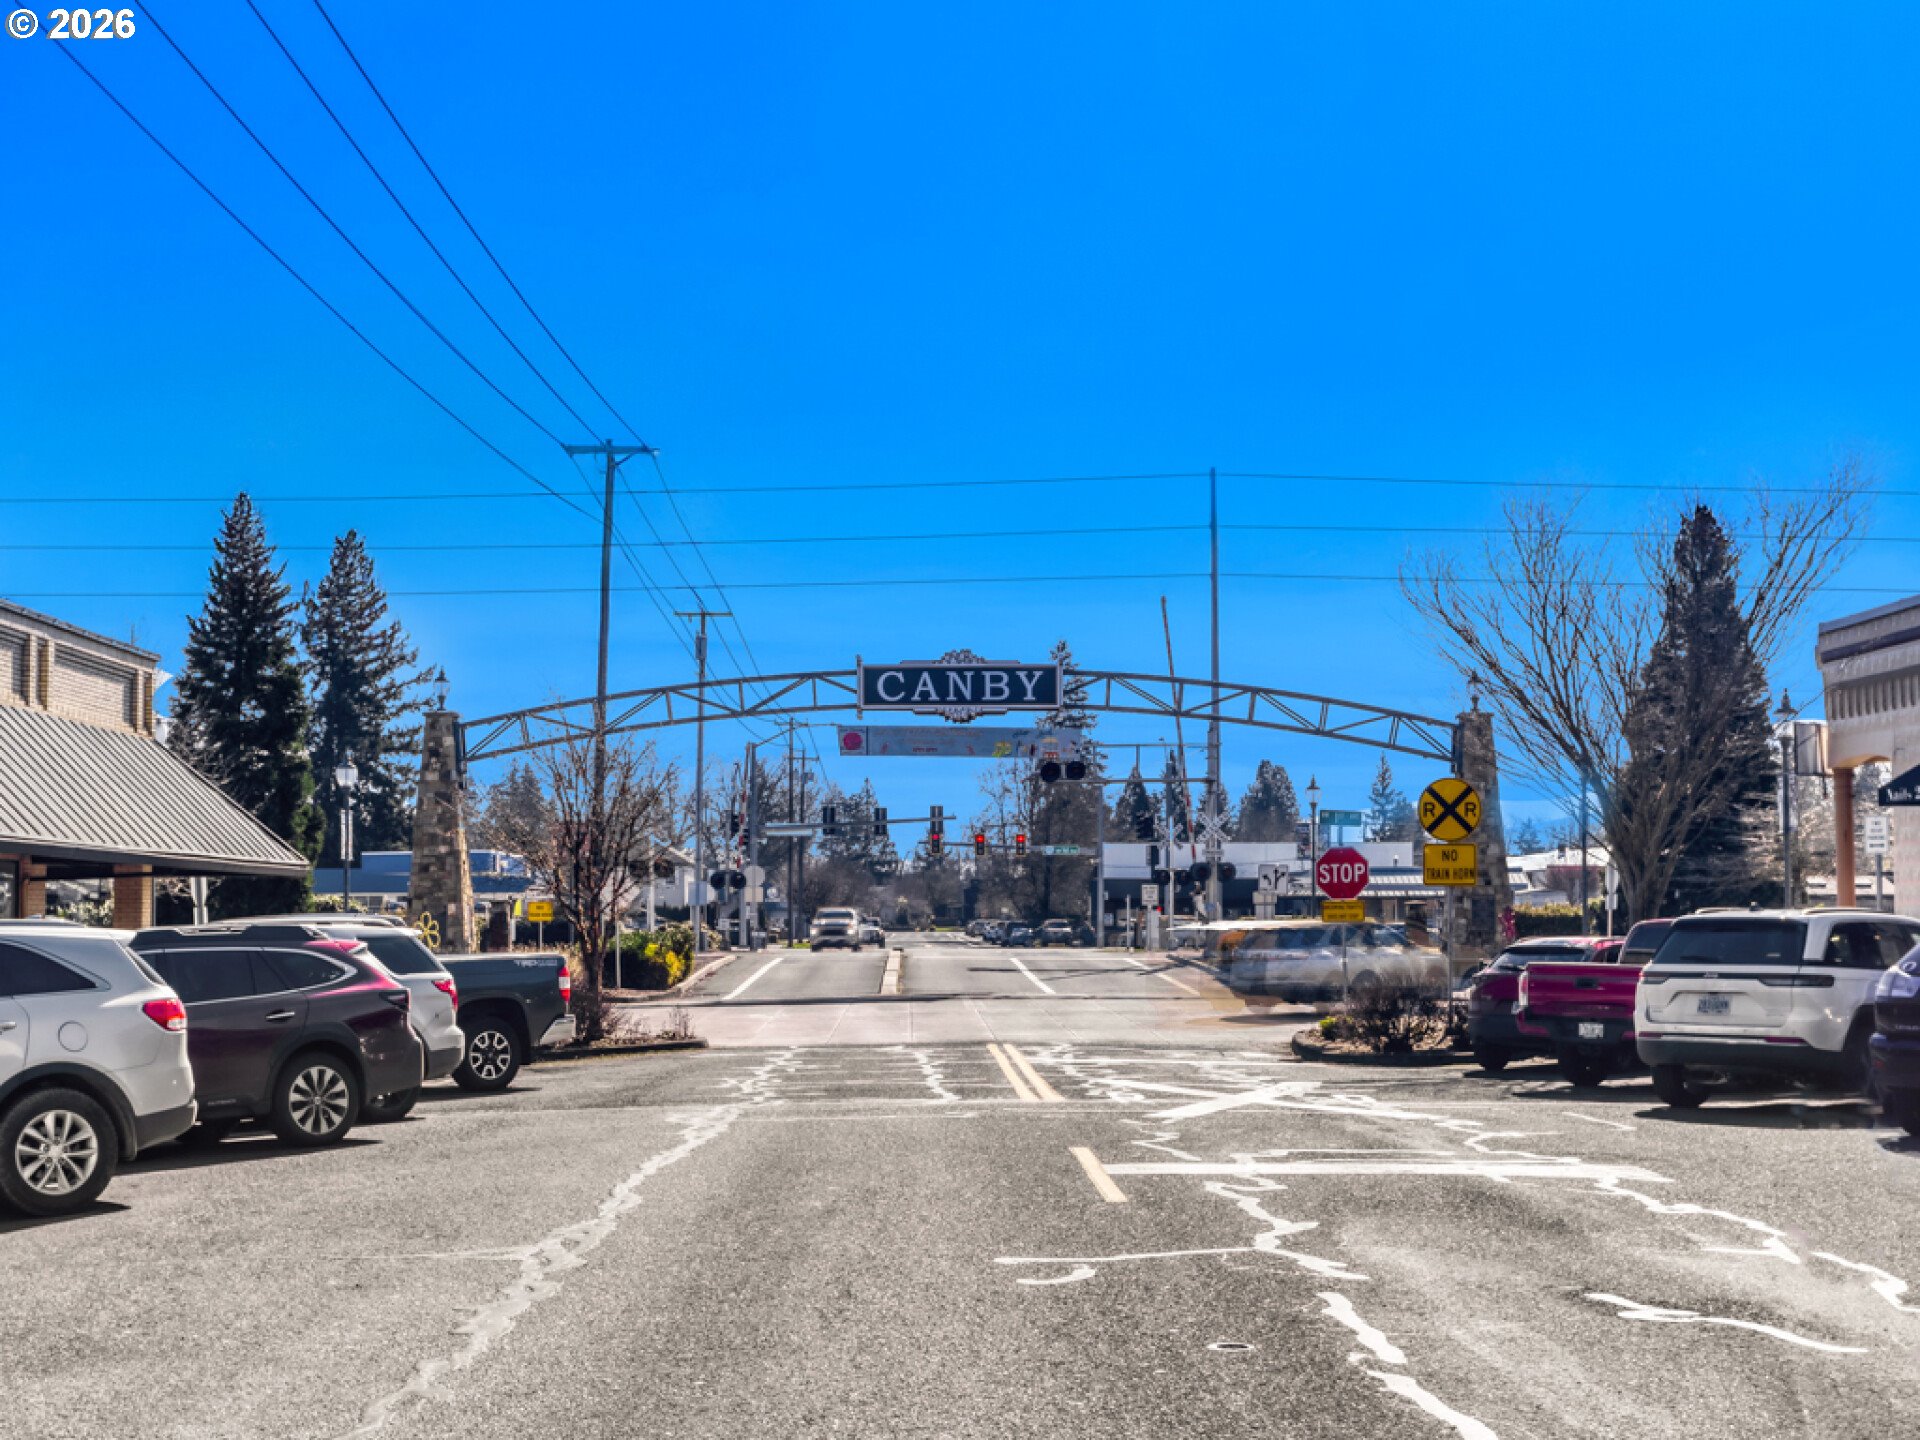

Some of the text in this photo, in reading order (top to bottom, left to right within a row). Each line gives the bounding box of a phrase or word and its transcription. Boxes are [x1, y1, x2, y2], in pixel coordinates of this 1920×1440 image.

[876, 670, 1044, 702] CANBY
[1423, 801, 1477, 818] R R
[1441, 848, 1458, 861] NO
[1319, 863, 1366, 884] STOP
[1426, 867, 1450, 880] TRAIN
